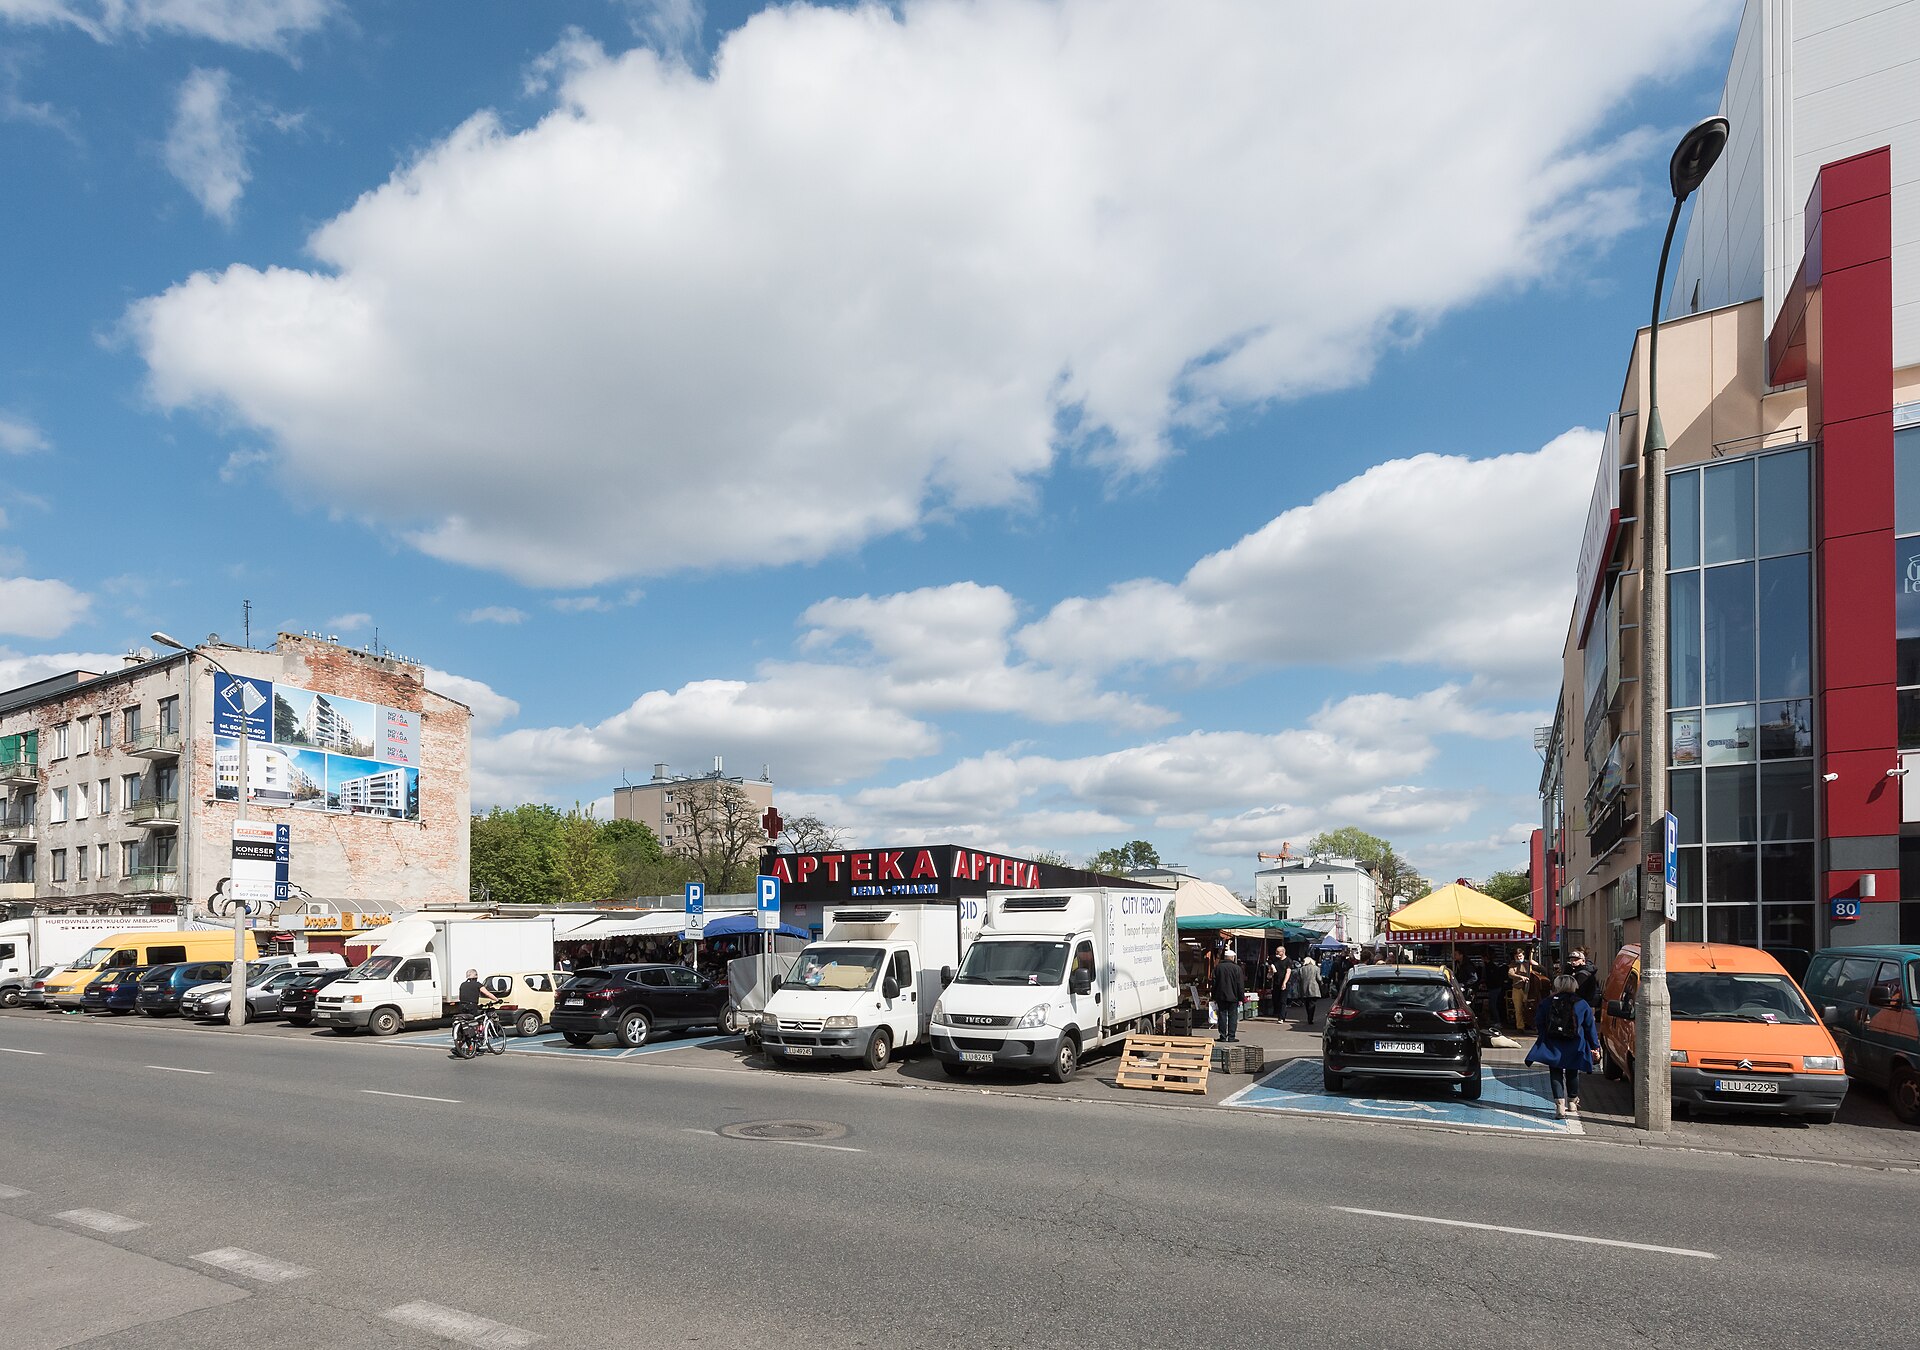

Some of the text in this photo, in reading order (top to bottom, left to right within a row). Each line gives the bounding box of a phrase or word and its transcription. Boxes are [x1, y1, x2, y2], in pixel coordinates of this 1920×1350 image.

[225, 681, 243, 698] Grua
[387, 711, 404, 719] NOVA
[387, 728, 403, 736] NOVA
[1668, 819, 1675, 864] P
[235, 846, 274, 855] KONESER
[771, 849, 938, 884] APTEKA
[952, 850, 1041, 890] APTEKA
[689, 885, 701, 905] P
[762, 879, 776, 908] P
[1121, 896, 1162, 915] CITY FROID
[1835, 903, 1856, 915] 80
[304, 913, 392, 928] Drogerie Polskie
[965, 1016, 993, 1024] IVECO
[1395, 1042, 1422, 1051] 70084
[1721, 1081, 1777, 1093] LLU 42295
